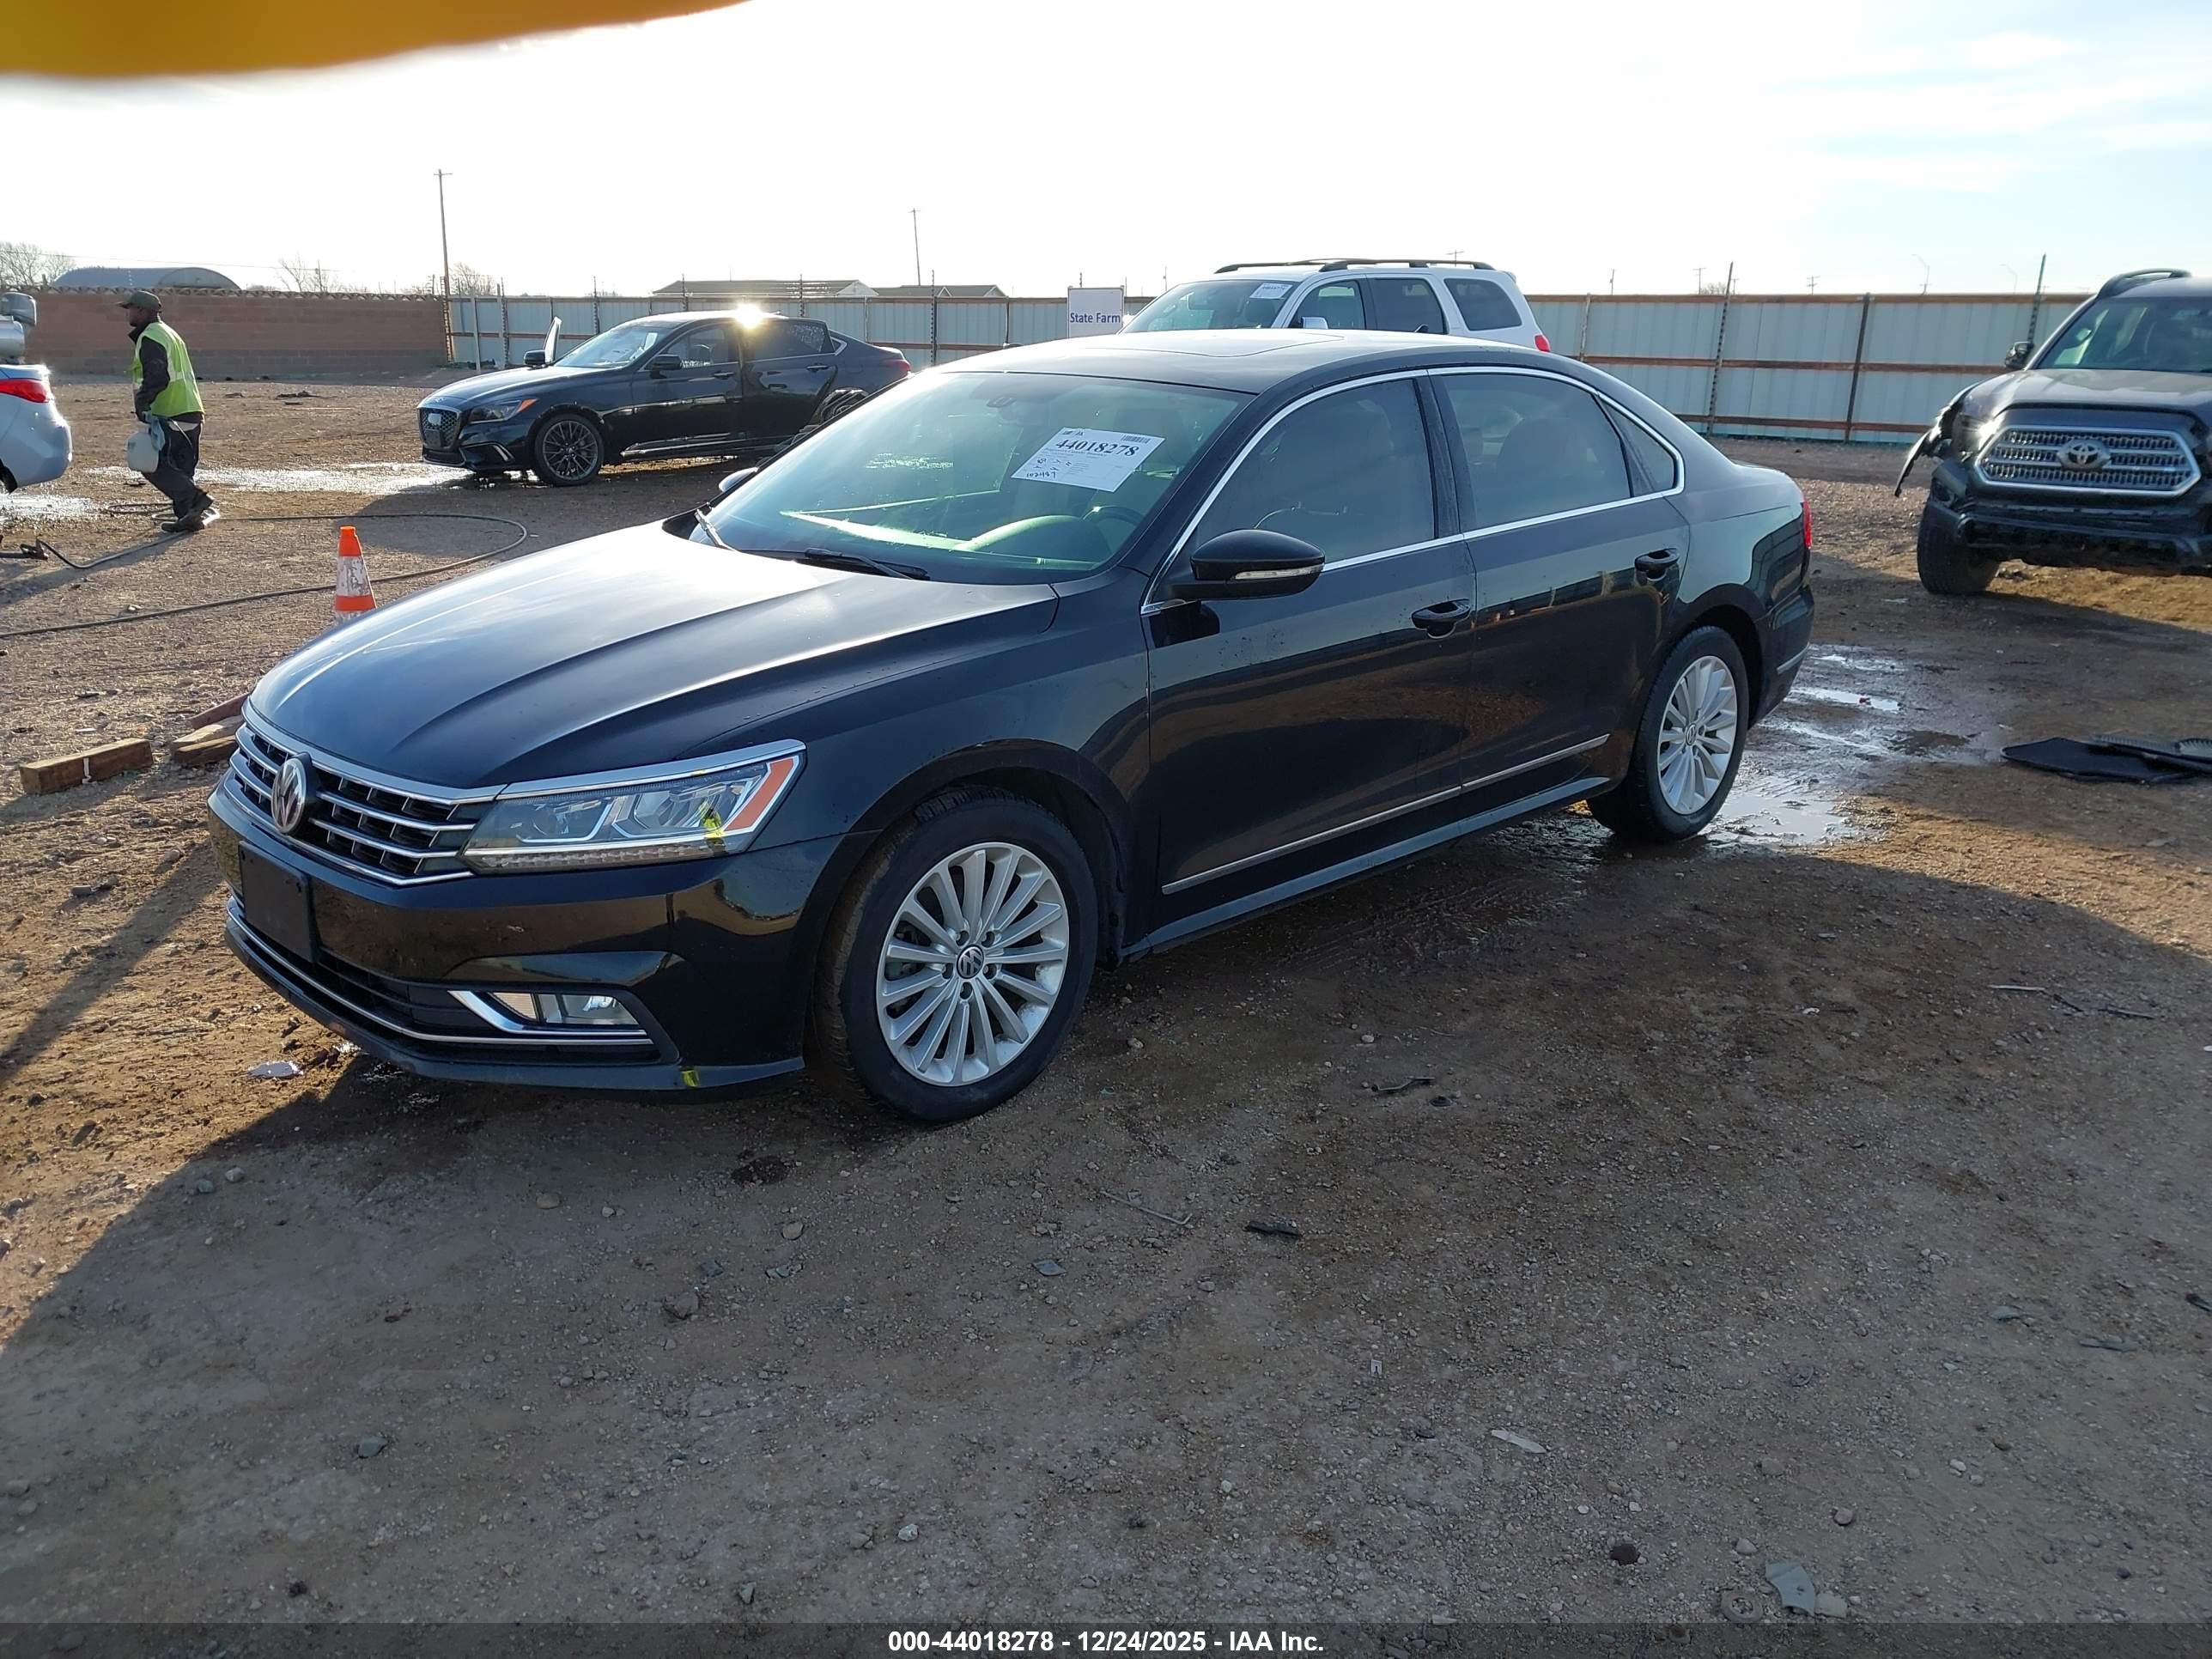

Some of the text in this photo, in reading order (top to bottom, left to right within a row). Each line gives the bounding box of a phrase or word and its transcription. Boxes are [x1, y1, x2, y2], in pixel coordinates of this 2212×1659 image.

[1070, 312, 1121, 323] State Farm
[1055, 439, 1140, 457] 44018278
